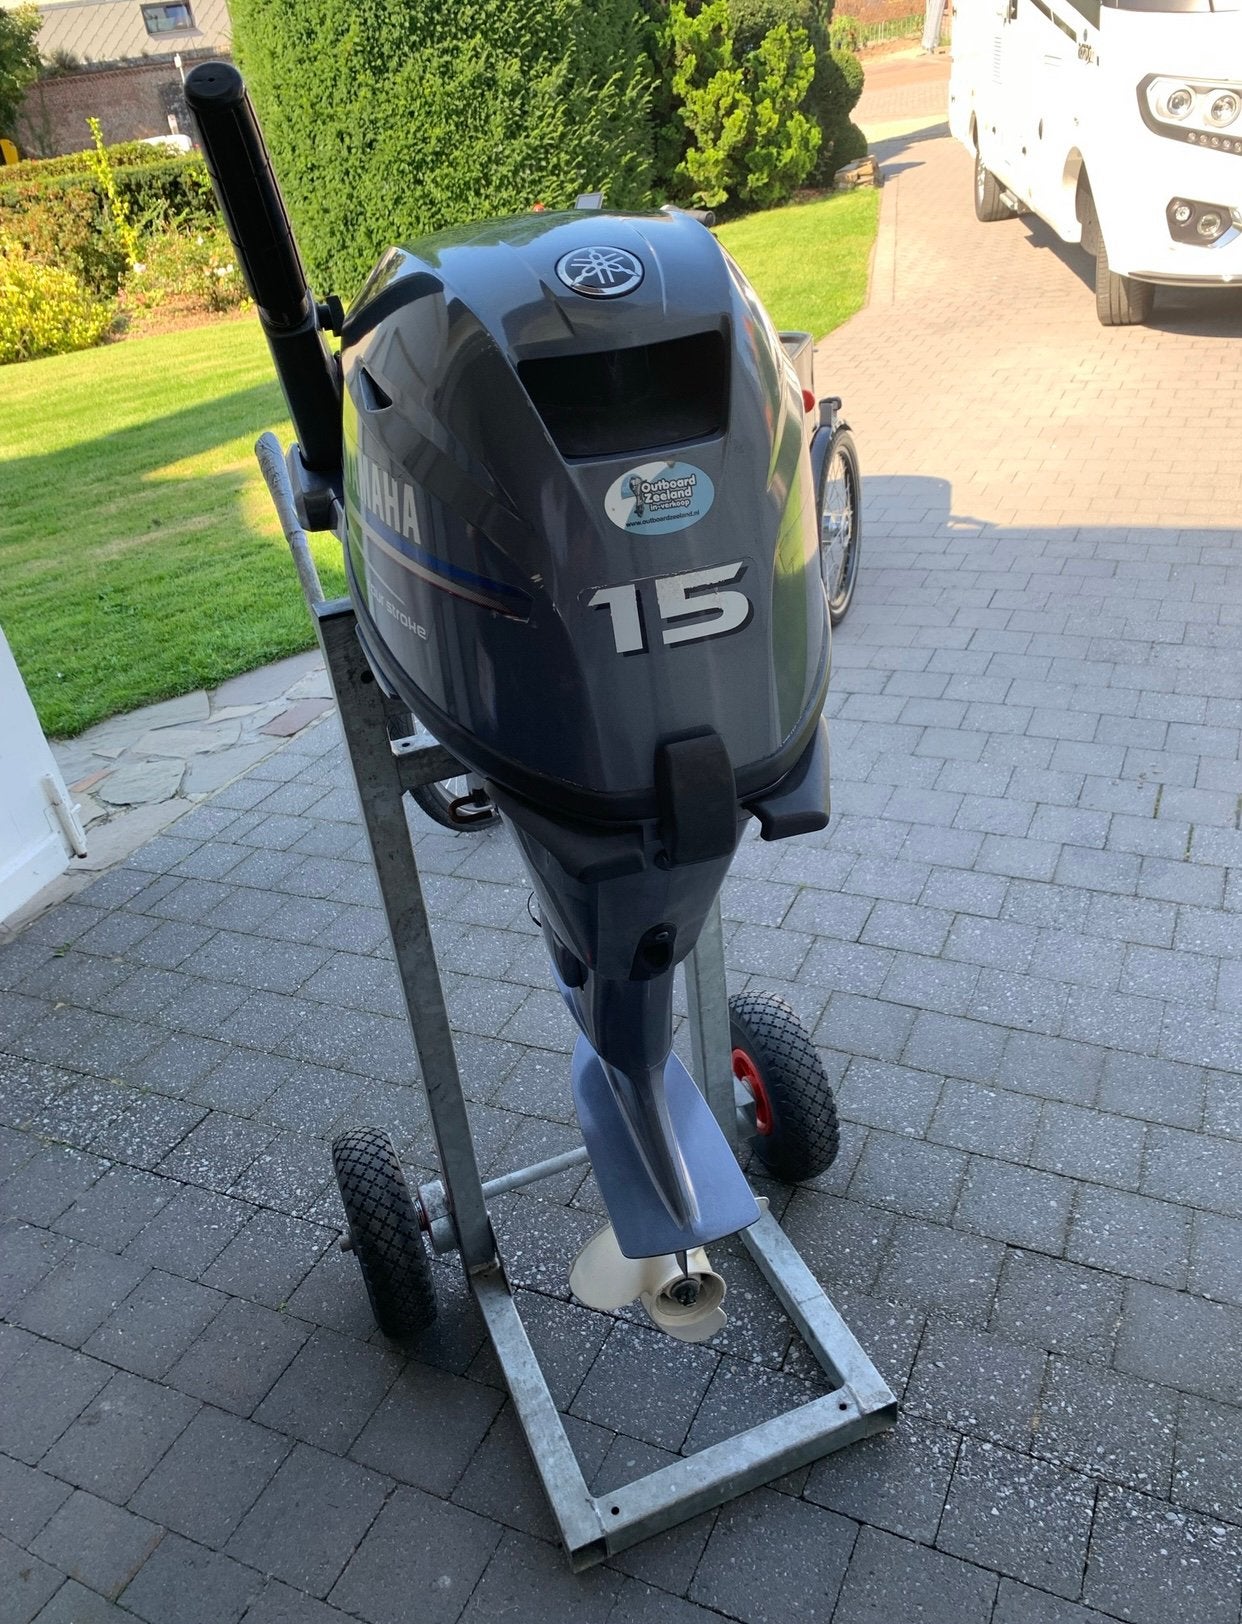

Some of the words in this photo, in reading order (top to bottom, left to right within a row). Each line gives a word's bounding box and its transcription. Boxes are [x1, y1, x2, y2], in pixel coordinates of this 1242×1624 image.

[641, 474, 696, 493] Outboard
[644, 486, 692, 504] Zeeland
[650, 499, 690, 511] in-verkoop
[626, 509, 700, 528] www.outboardzeeland.nl
[587, 560, 755, 658] 15
[385, 600, 427, 640] stroke
